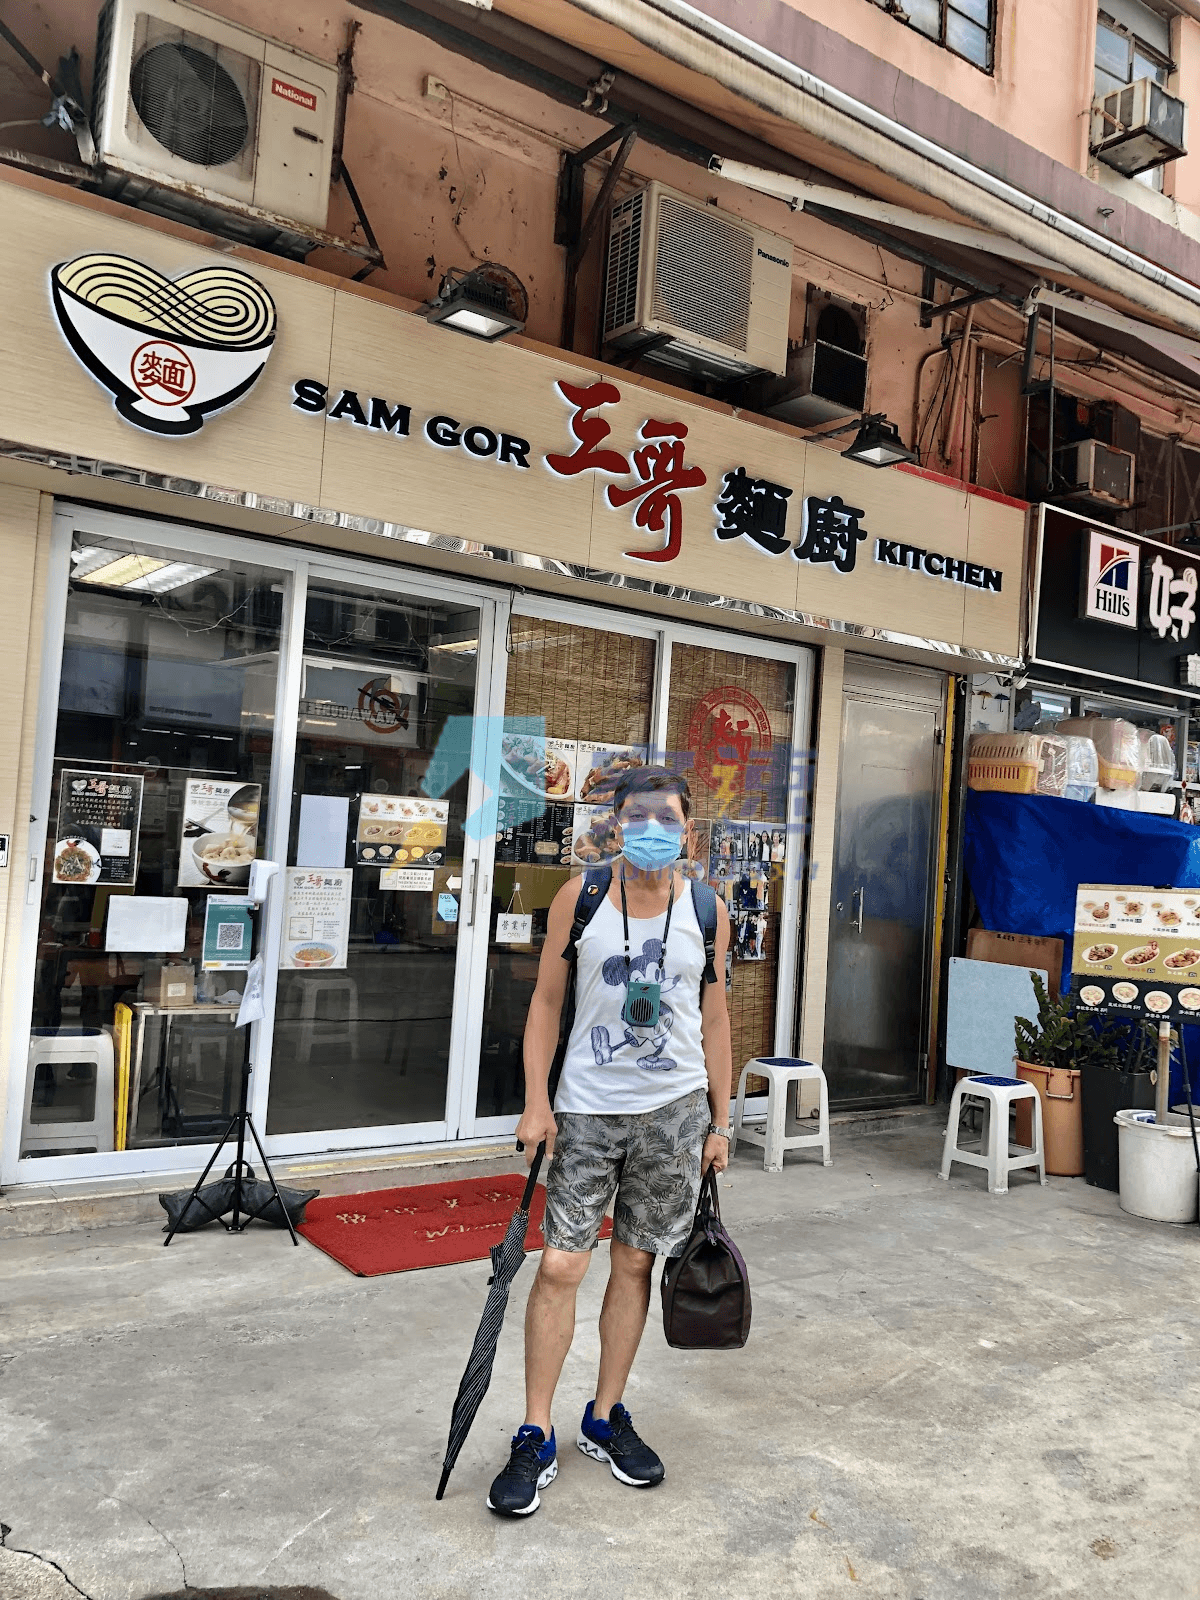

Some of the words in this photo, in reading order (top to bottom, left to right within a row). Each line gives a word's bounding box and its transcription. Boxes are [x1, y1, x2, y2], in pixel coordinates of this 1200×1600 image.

[275, 83, 313, 106] National
[757, 248, 790, 268] Panasonic
[138, 351, 189, 397] 麵
[293, 378, 411, 436] SAM
[426, 415, 531, 468] GOR
[877, 538, 1003, 593] KITCHEN
[1095, 588, 1131, 617] Hill's
